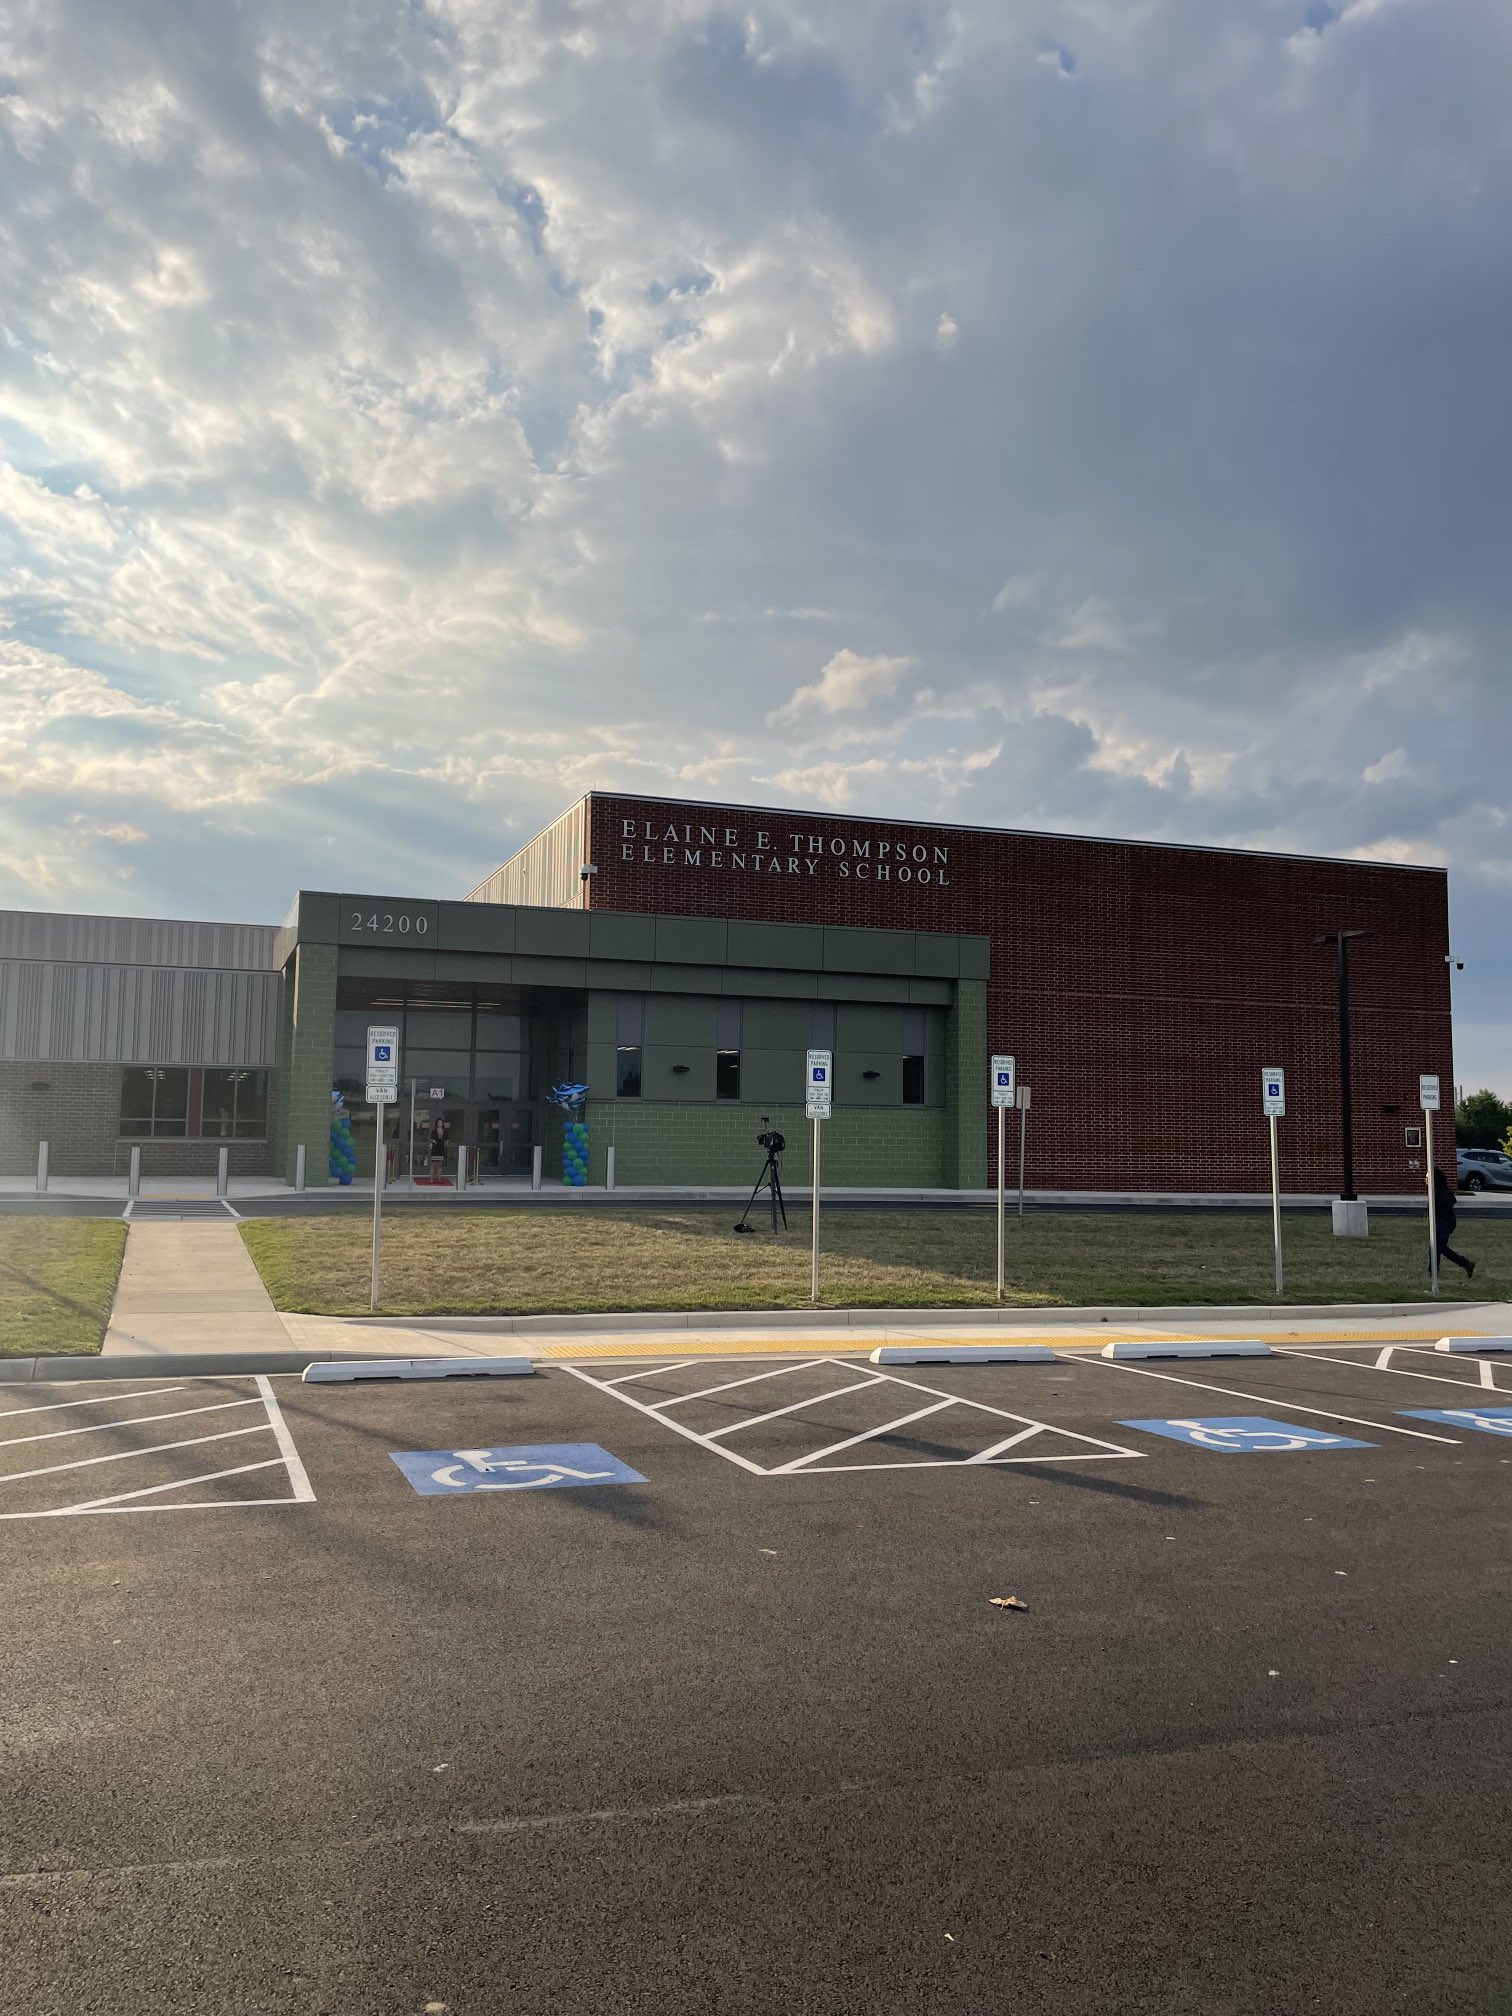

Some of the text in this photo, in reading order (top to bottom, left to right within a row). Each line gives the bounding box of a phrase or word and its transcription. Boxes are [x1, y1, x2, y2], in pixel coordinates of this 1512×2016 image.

[621, 819, 949, 865] ELAINE E. THOMPSON
[621, 844, 950, 885] ELEMENTARY SCHOOL
[351, 912, 428, 934] 24200
[431, 1089, 443, 1098] A1
